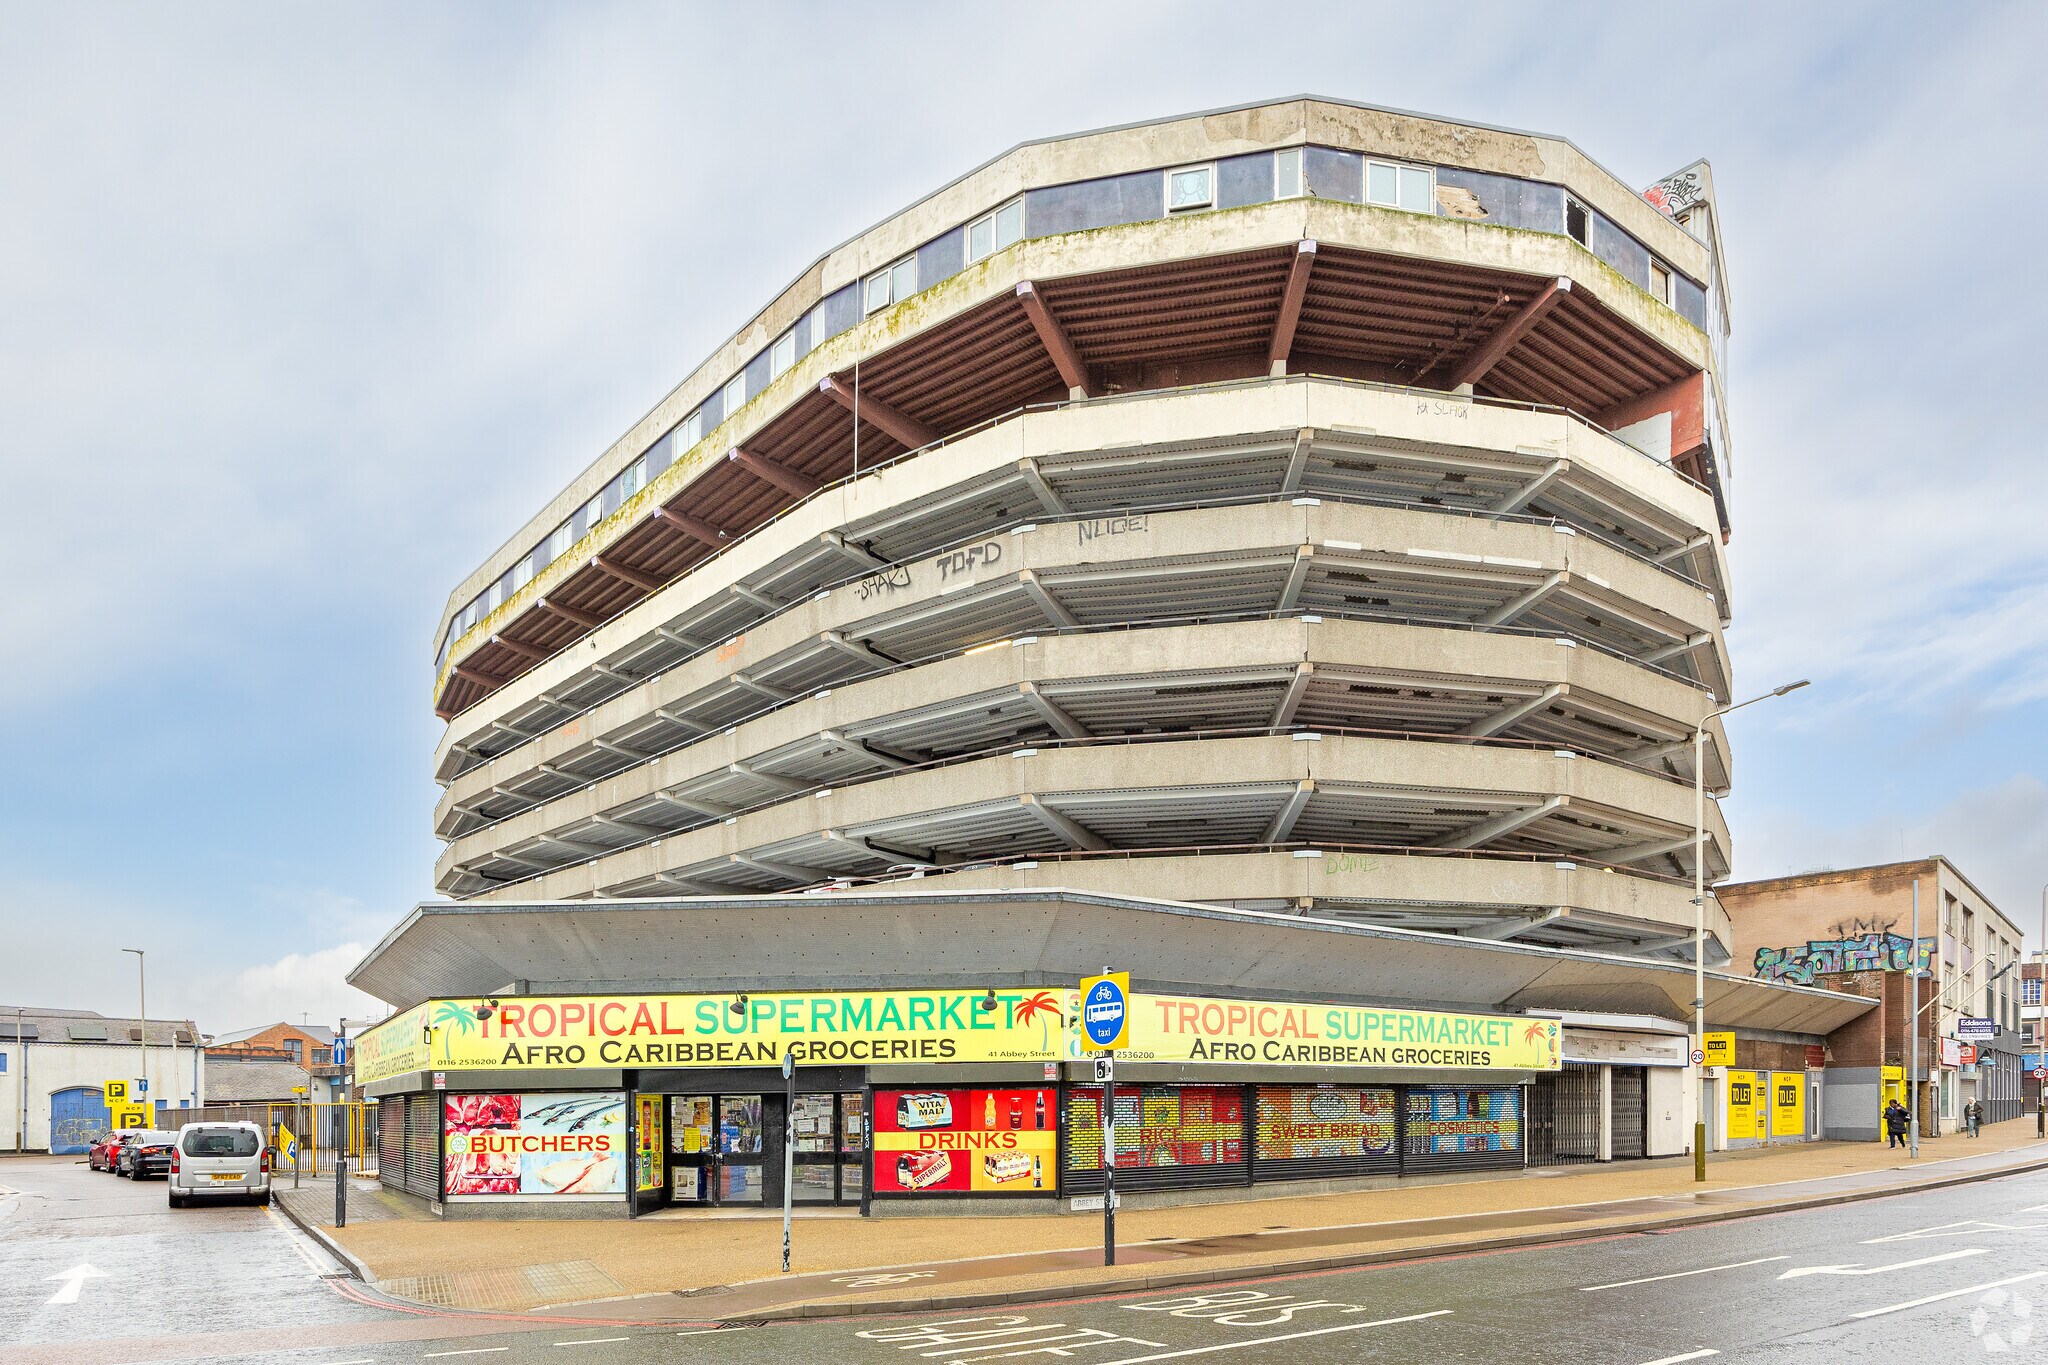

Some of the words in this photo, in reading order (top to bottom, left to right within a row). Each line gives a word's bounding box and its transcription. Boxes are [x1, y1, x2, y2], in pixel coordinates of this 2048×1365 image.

[473, 1001, 685, 1039] TROPICAL
[695, 994, 1023, 1035] SUPERMARKET
[1156, 1000, 1319, 1040] TROPICAL
[1326, 1010, 1513, 1048] SUPERMARKET
[1097, 1027, 1112, 1038] taxi
[501, 1042, 586, 1065] AFRO
[600, 1040, 777, 1064] CARIBBEAN
[787, 1038, 956, 1061] GROCERIES
[1000, 1050, 1028, 1059] Abbey
[1029, 1050, 1056, 1058] Street
[1117, 1051, 1155, 1059] 2536200
[1189, 1038, 1256, 1061] AFRO
[1263, 1040, 1386, 1064] CARIBBEAN
[1392, 1047, 1491, 1066] GROCERIES
[459, 1058, 497, 1066] 2536200
[1731, 1087, 1740, 1102] TO
[1740, 1087, 1751, 1102] LET
[1778, 1089, 1786, 1104] TO
[1786, 1089, 1796, 1104] LET
[918, 1100, 942, 1109] VITA
[918, 1107, 946, 1116] MALT
[1140, 1127, 1184, 1144] RICE
[1271, 1123, 1327, 1140] SWEET
[1330, 1123, 1381, 1138] BREAD
[1428, 1120, 1501, 1136] COSMETICS
[471, 1135, 611, 1153] BUTCHERS
[919, 1132, 1018, 1149] DRINKS
[913, 1158, 948, 1185] SUPERMALT
[1073, 1199, 1094, 1208] ABBEY
